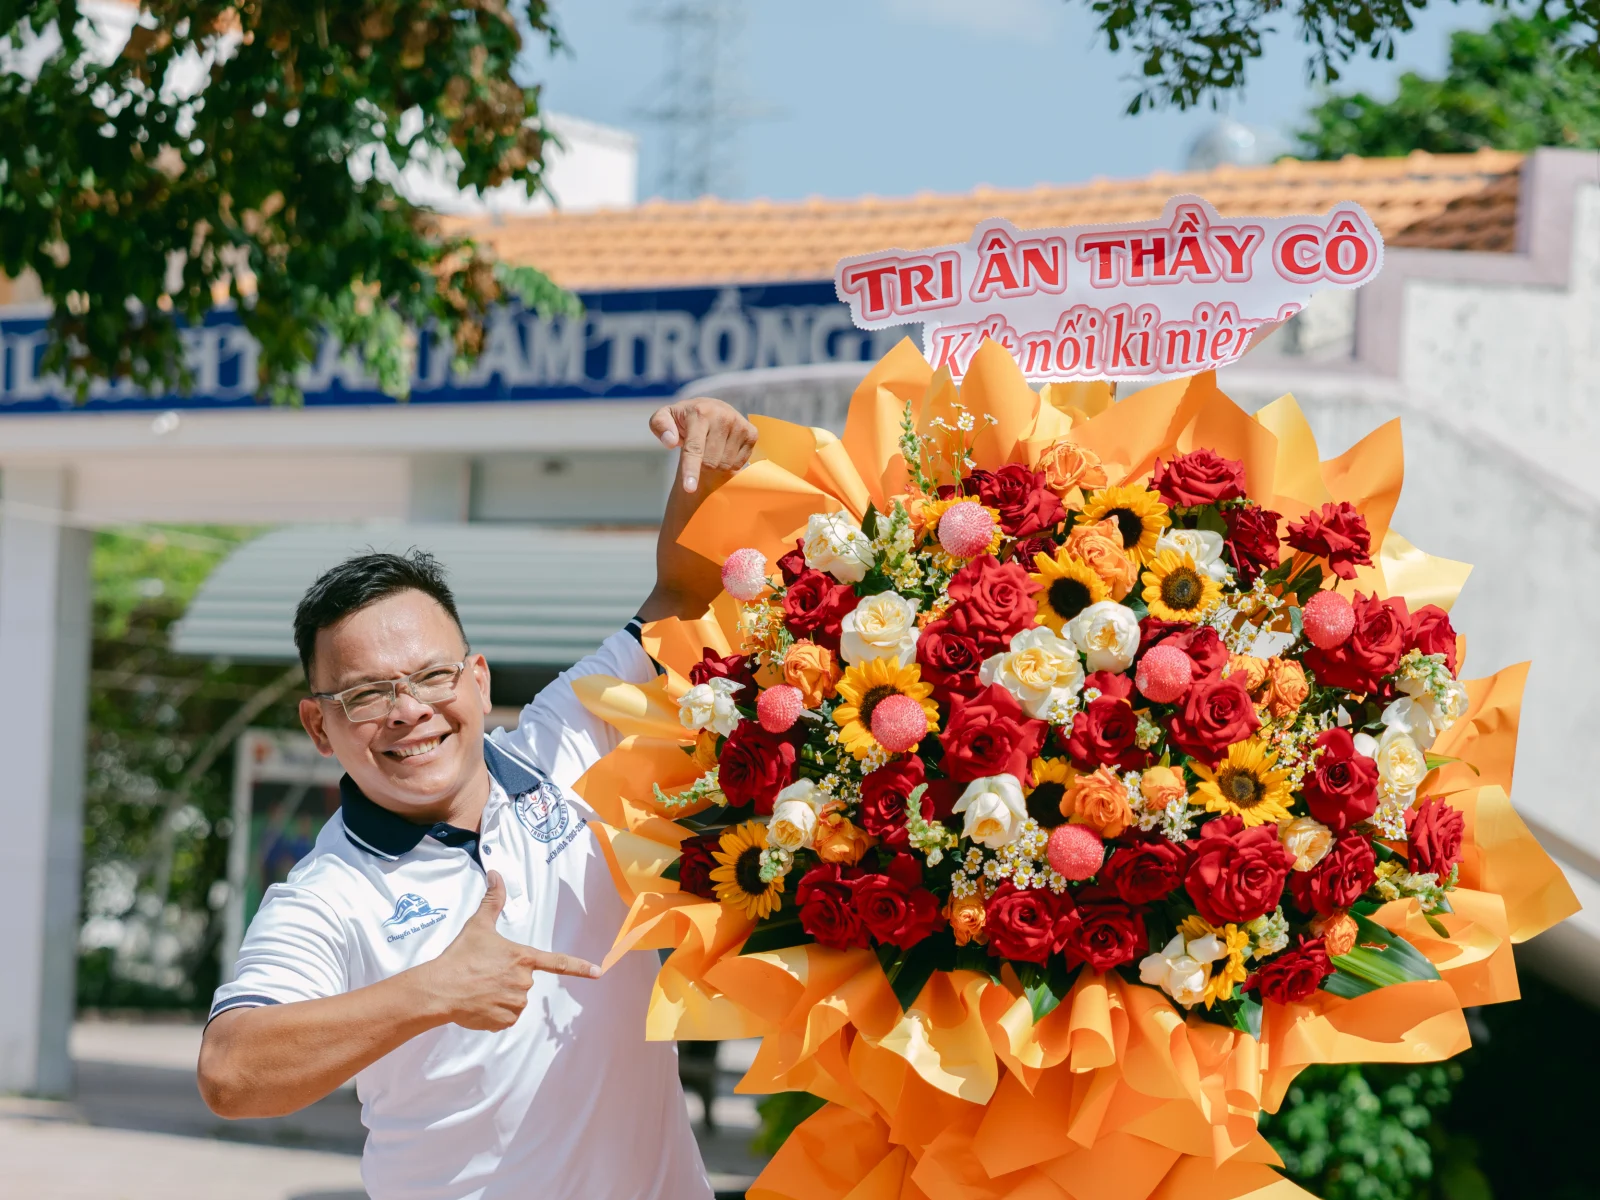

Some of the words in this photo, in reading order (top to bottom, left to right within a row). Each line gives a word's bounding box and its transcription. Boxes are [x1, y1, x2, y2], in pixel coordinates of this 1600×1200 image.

[850, 259, 956, 313] TRI
[977, 235, 1060, 294] ÂN
[1083, 211, 1256, 281] THẦY
[1279, 219, 1369, 275] CÔ
[1025, 312, 1097, 373] nối
[1111, 311, 1153, 368] kỉ
